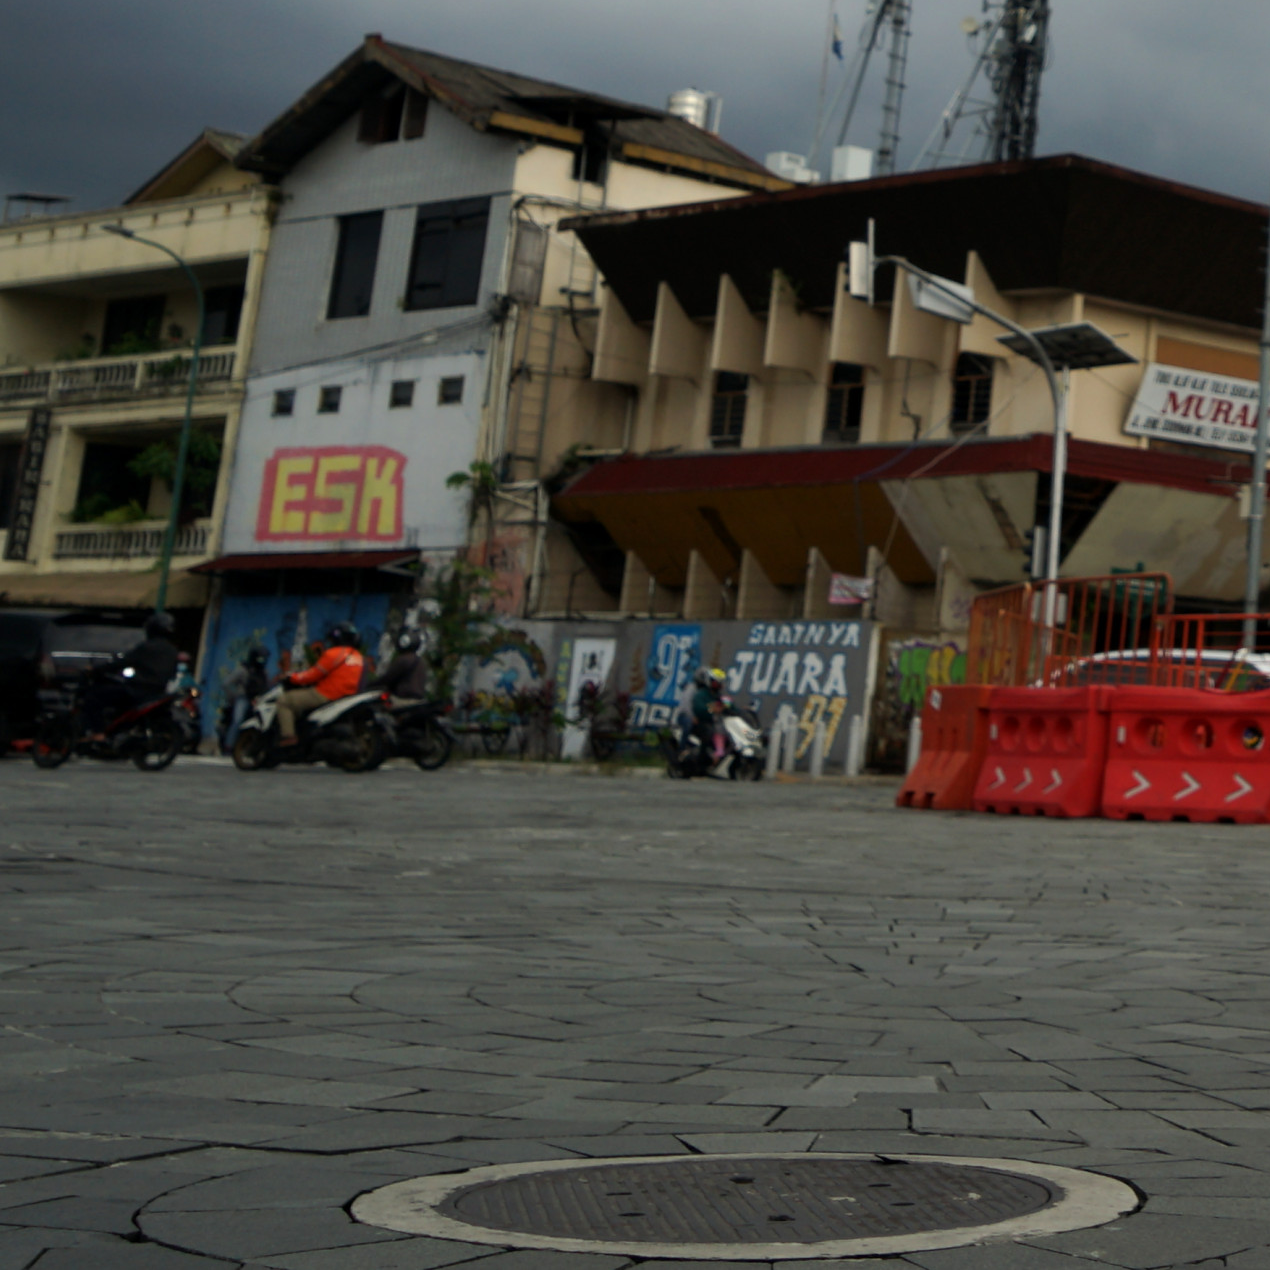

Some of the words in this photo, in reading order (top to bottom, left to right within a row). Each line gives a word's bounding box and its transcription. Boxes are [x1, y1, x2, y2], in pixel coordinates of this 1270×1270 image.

[266, 454, 399, 535] ESK
[748, 622, 861, 648] SAATNYA
[728, 651, 848, 696] JUARA
